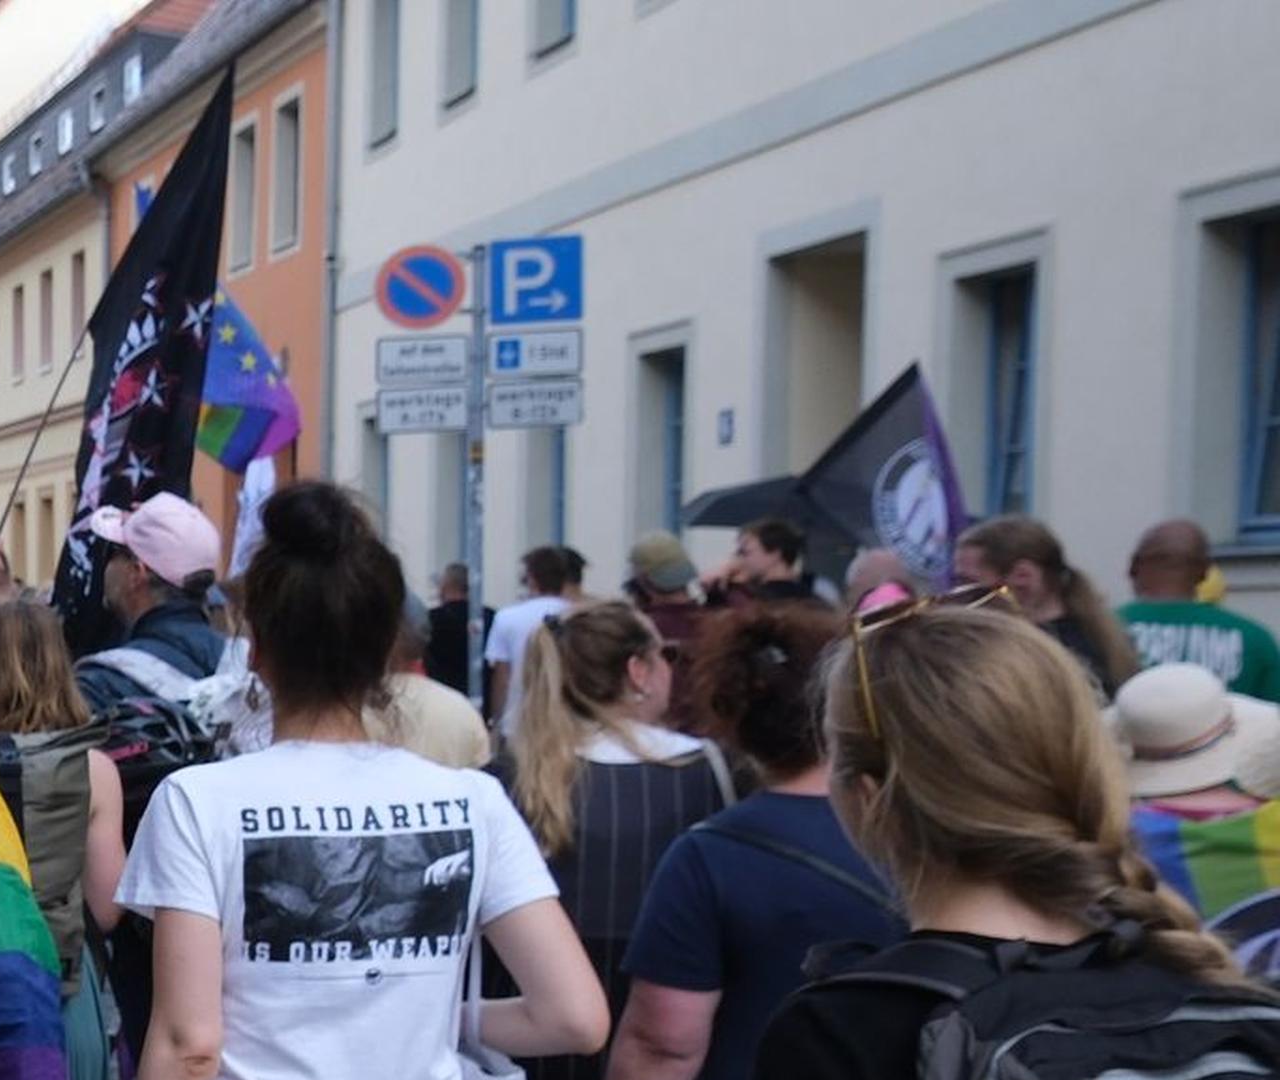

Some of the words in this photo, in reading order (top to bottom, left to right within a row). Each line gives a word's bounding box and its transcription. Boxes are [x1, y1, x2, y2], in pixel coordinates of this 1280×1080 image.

[503, 248, 556, 316] P
[240, 797, 470, 833] SOLIDARITY
[289, 940, 353, 962] OUR
